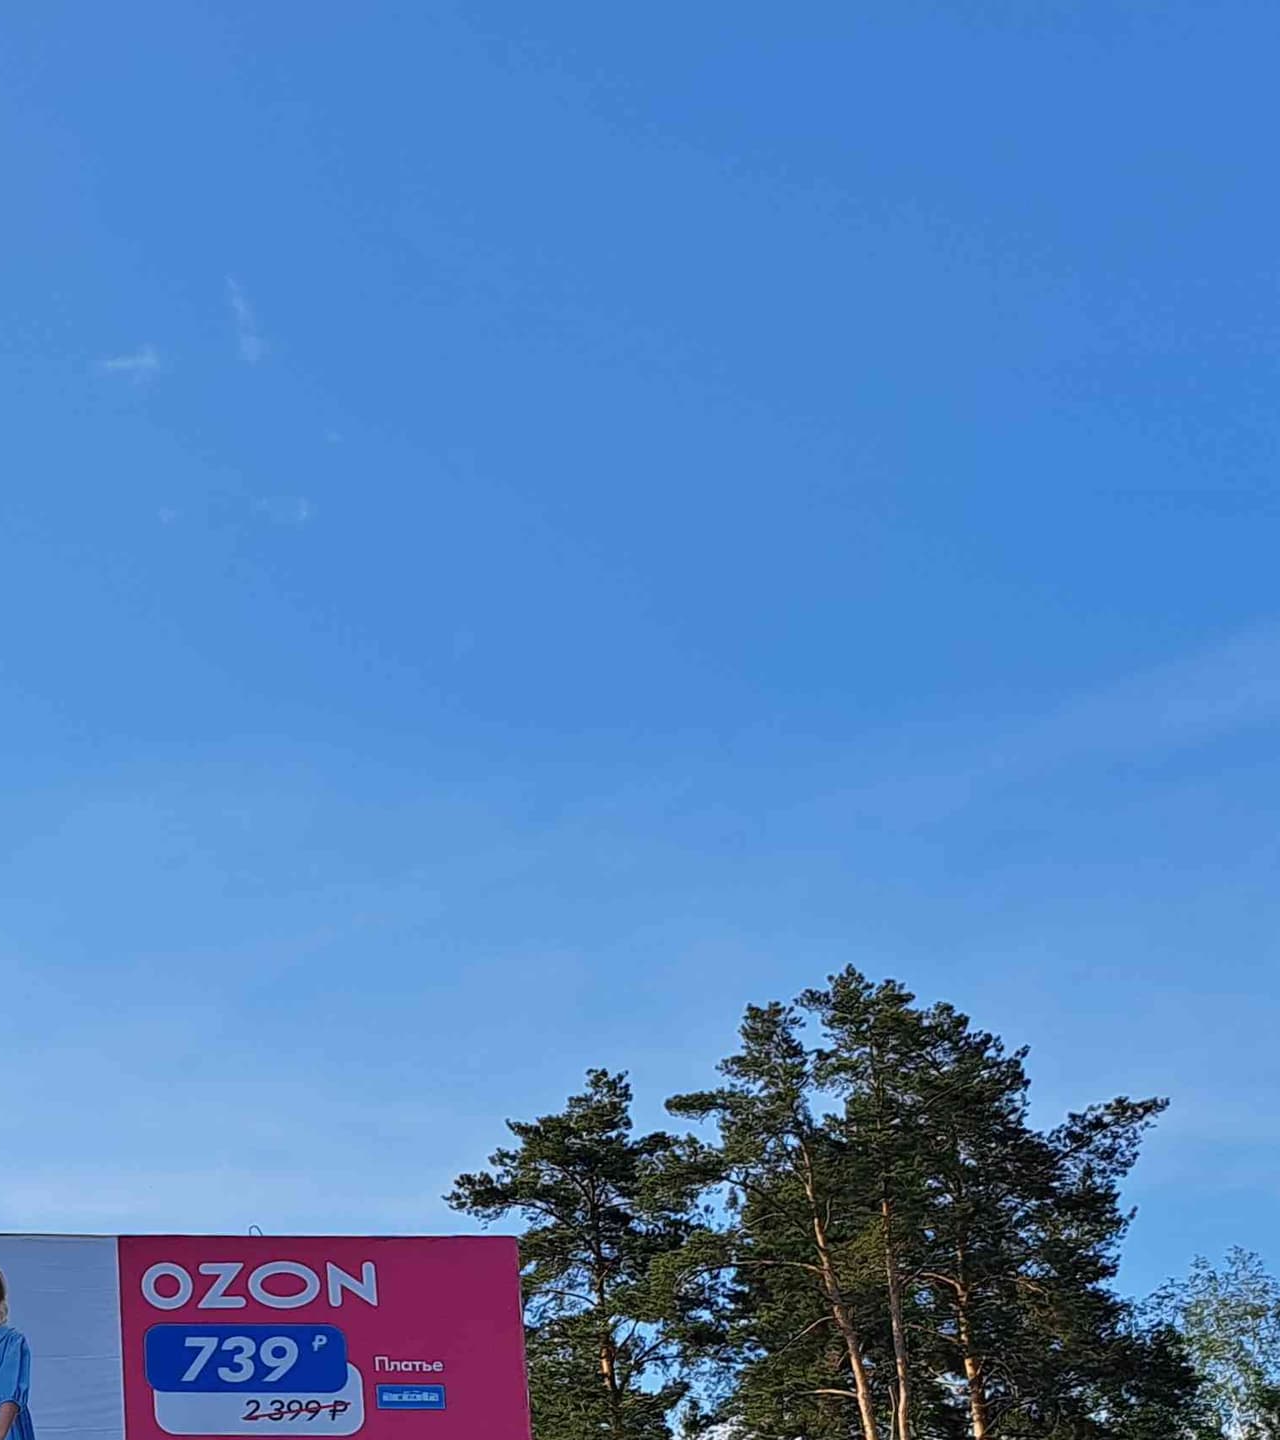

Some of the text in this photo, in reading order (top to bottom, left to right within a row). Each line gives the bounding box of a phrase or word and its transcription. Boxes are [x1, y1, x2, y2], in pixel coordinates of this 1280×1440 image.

[141, 1260, 379, 1310] OZON
[180, 1335, 299, 1383] 739
[374, 1355, 444, 1372] Платье
